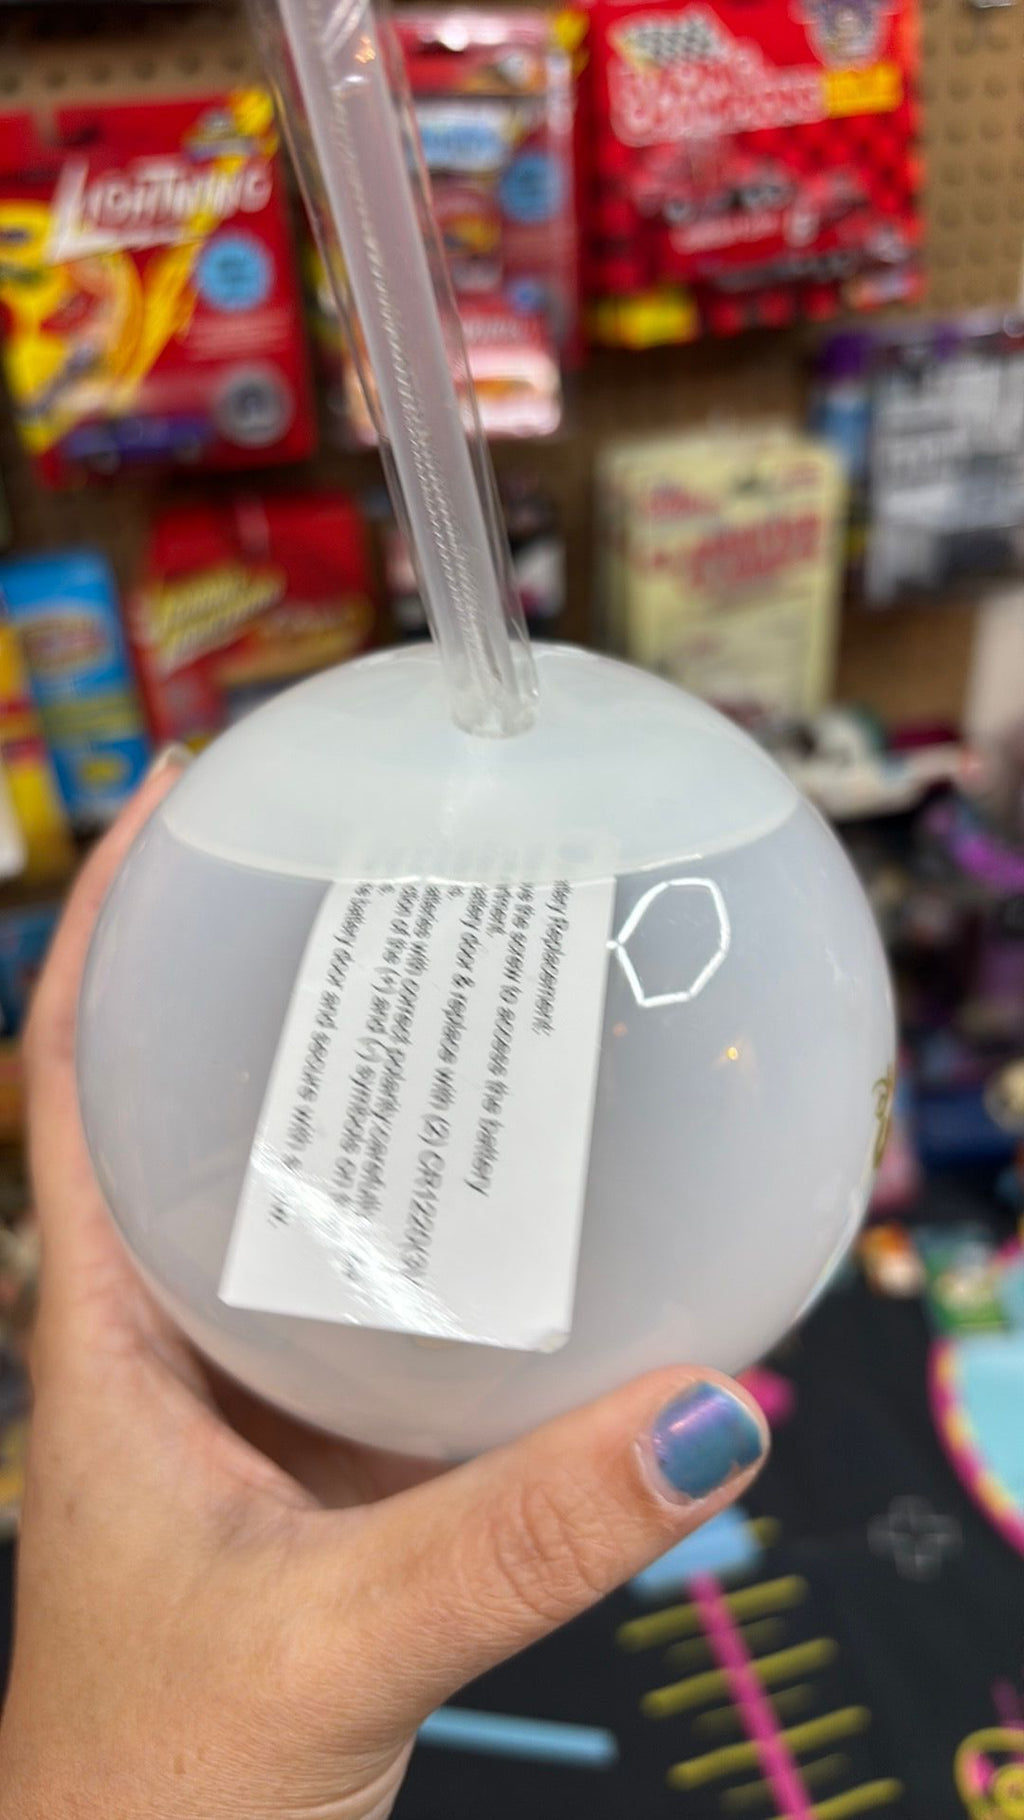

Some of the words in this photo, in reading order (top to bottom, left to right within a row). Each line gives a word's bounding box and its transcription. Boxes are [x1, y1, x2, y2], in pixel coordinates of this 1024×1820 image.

[333, 897, 371, 947] battery
[388, 917, 411, 938] of
[511, 903, 536, 930] the
[325, 947, 353, 990] door
[382, 937, 409, 966] the
[404, 940, 431, 977] with
[456, 931, 483, 972] door
[504, 931, 528, 983] screw
[451, 972, 475, 990] &
[500, 984, 522, 1005] to
[315, 990, 341, 1030] and
[364, 995, 391, 1035] and
[389, 977, 421, 1046] correct
[437, 992, 469, 1066] replace
[487, 1004, 516, 1077] access
[297, 1030, 332, 1102] secure
[338, 1063, 377, 1155] symbols
[429, 1066, 457, 1112] with
[481, 1078, 509, 1115] the
[285, 1104, 316, 1153] with
[417, 1112, 452, 1148] (2)
[331, 1156, 358, 1190] on
[464, 1116, 503, 1198] battery
